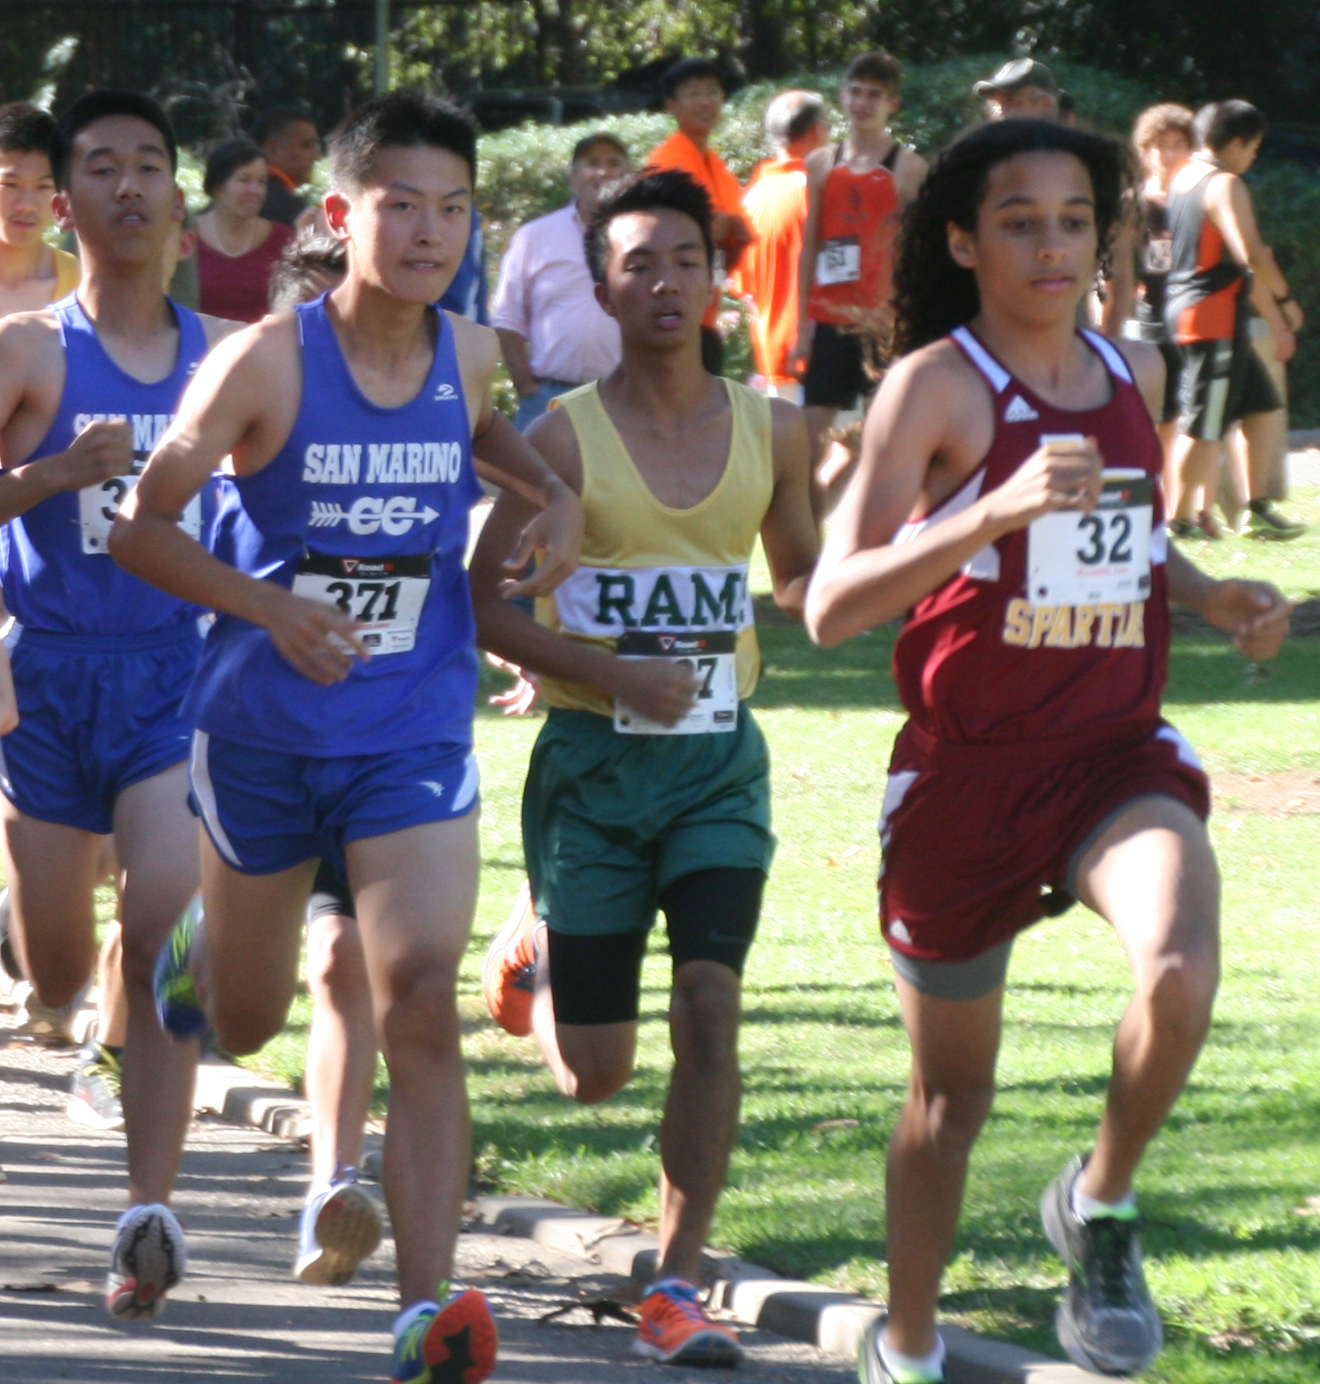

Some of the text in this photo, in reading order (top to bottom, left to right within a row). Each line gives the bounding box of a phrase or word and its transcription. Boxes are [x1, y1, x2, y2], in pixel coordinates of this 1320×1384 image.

[302, 441, 462, 485] SAN MARINO
[1077, 513, 1132, 565] 32
[325, 581, 402, 623] 371
[595, 572, 746, 627] RAM
